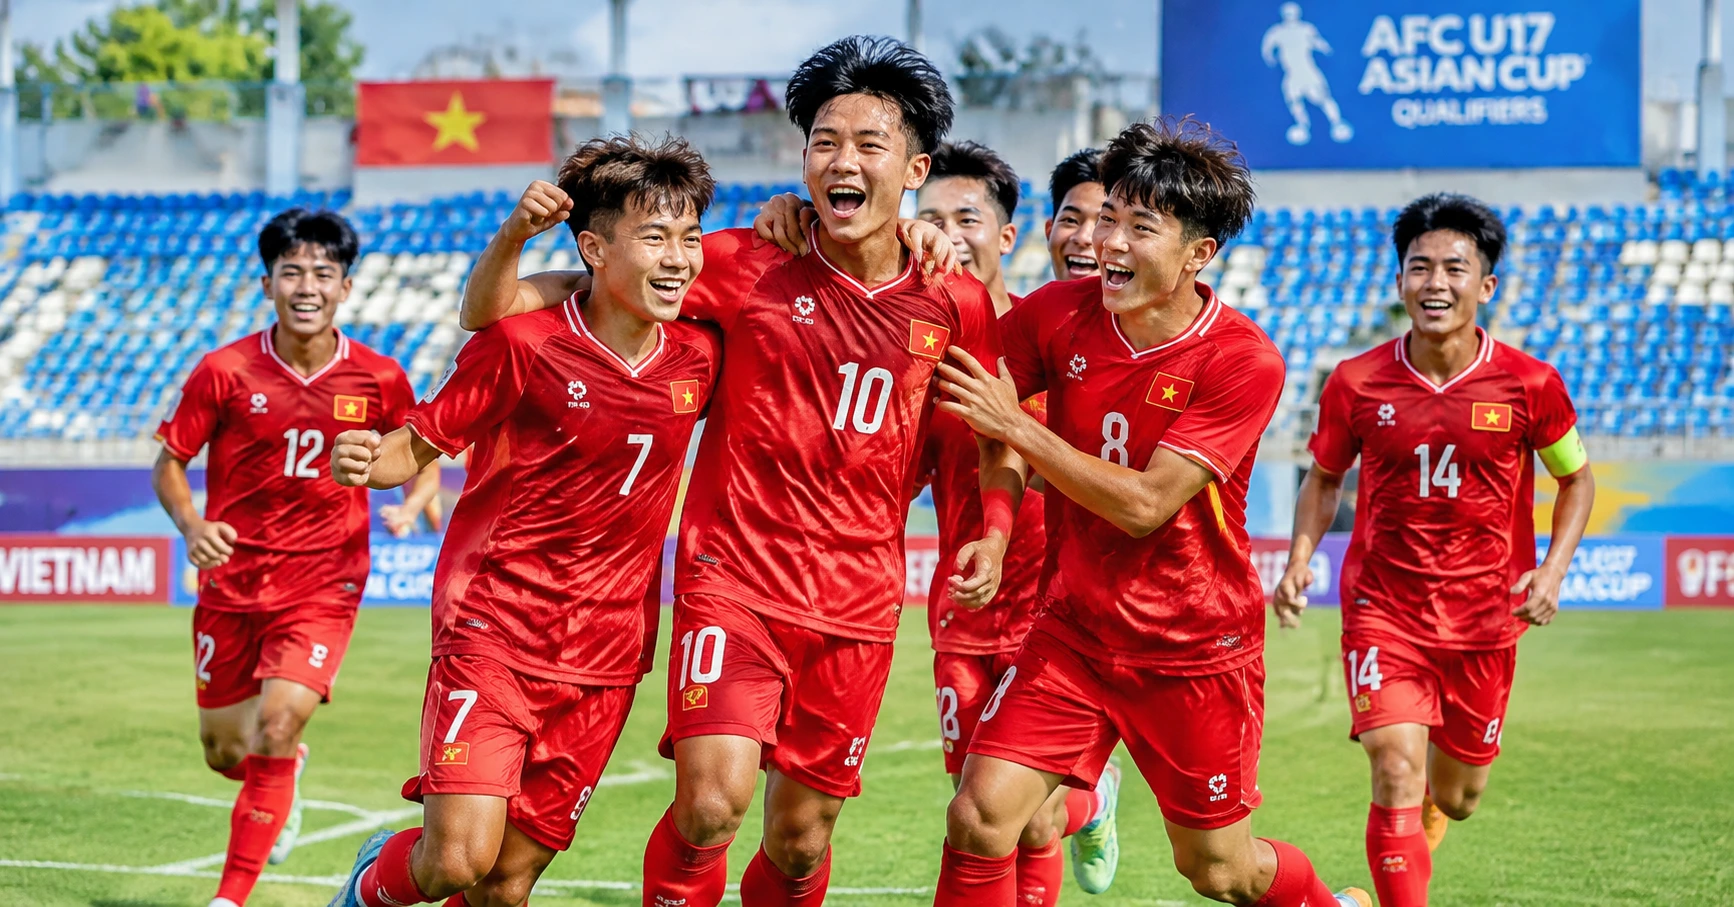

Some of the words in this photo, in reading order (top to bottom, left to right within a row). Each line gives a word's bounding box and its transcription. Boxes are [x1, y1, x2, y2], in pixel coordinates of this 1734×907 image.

[1361, 14, 1465, 57] AFC
[1468, 11, 1556, 55] U17
[1357, 55, 1497, 95] ASIAN
[1498, 53, 1587, 92] CUP
[1391, 96, 1549, 129] QUALIFIERS
[832, 361, 894, 435] 10
[283, 428, 325, 478] 12
[619, 434, 654, 496] 7
[1101, 411, 1129, 468] 8
[1414, 443, 1462, 498] 14
[0, 547, 156, 595] VIETNAM
[679, 626, 727, 691] 10
[1348, 646, 1383, 698] 14
[443, 689, 478, 744] 7
[980, 665, 1017, 722] 8
